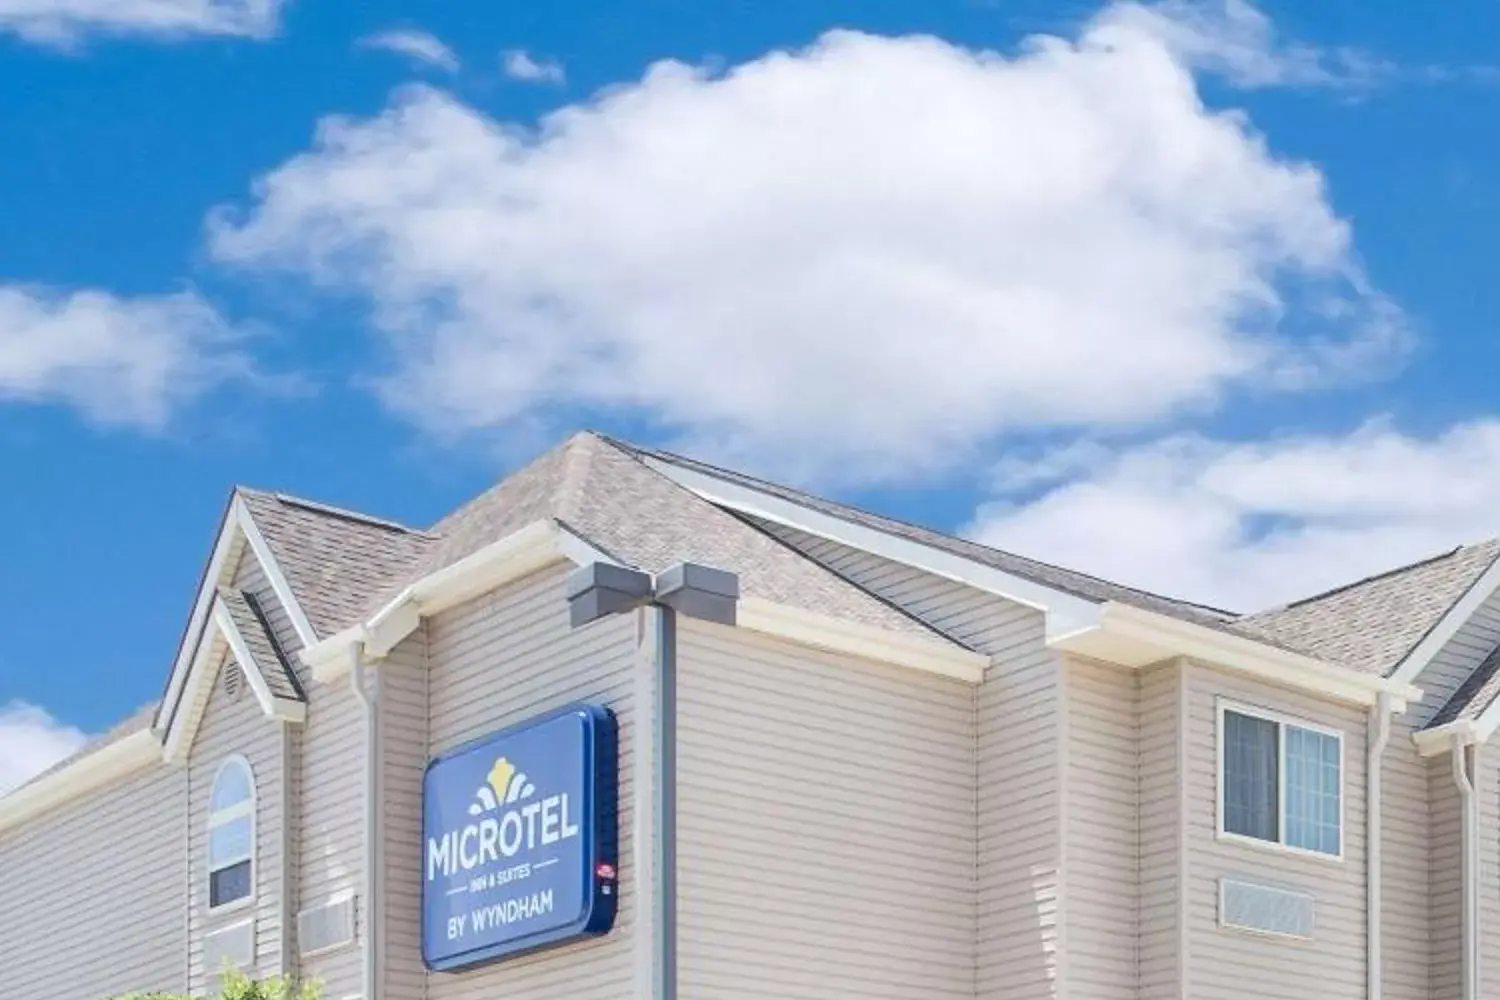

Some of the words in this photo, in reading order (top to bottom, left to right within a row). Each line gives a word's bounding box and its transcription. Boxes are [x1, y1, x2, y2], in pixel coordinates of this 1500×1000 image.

[427, 793, 579, 881] MICROTEL
[497, 863, 531, 885] SUITES
[447, 914, 467, 940] BY
[471, 888, 554, 934] WYNDHAM
